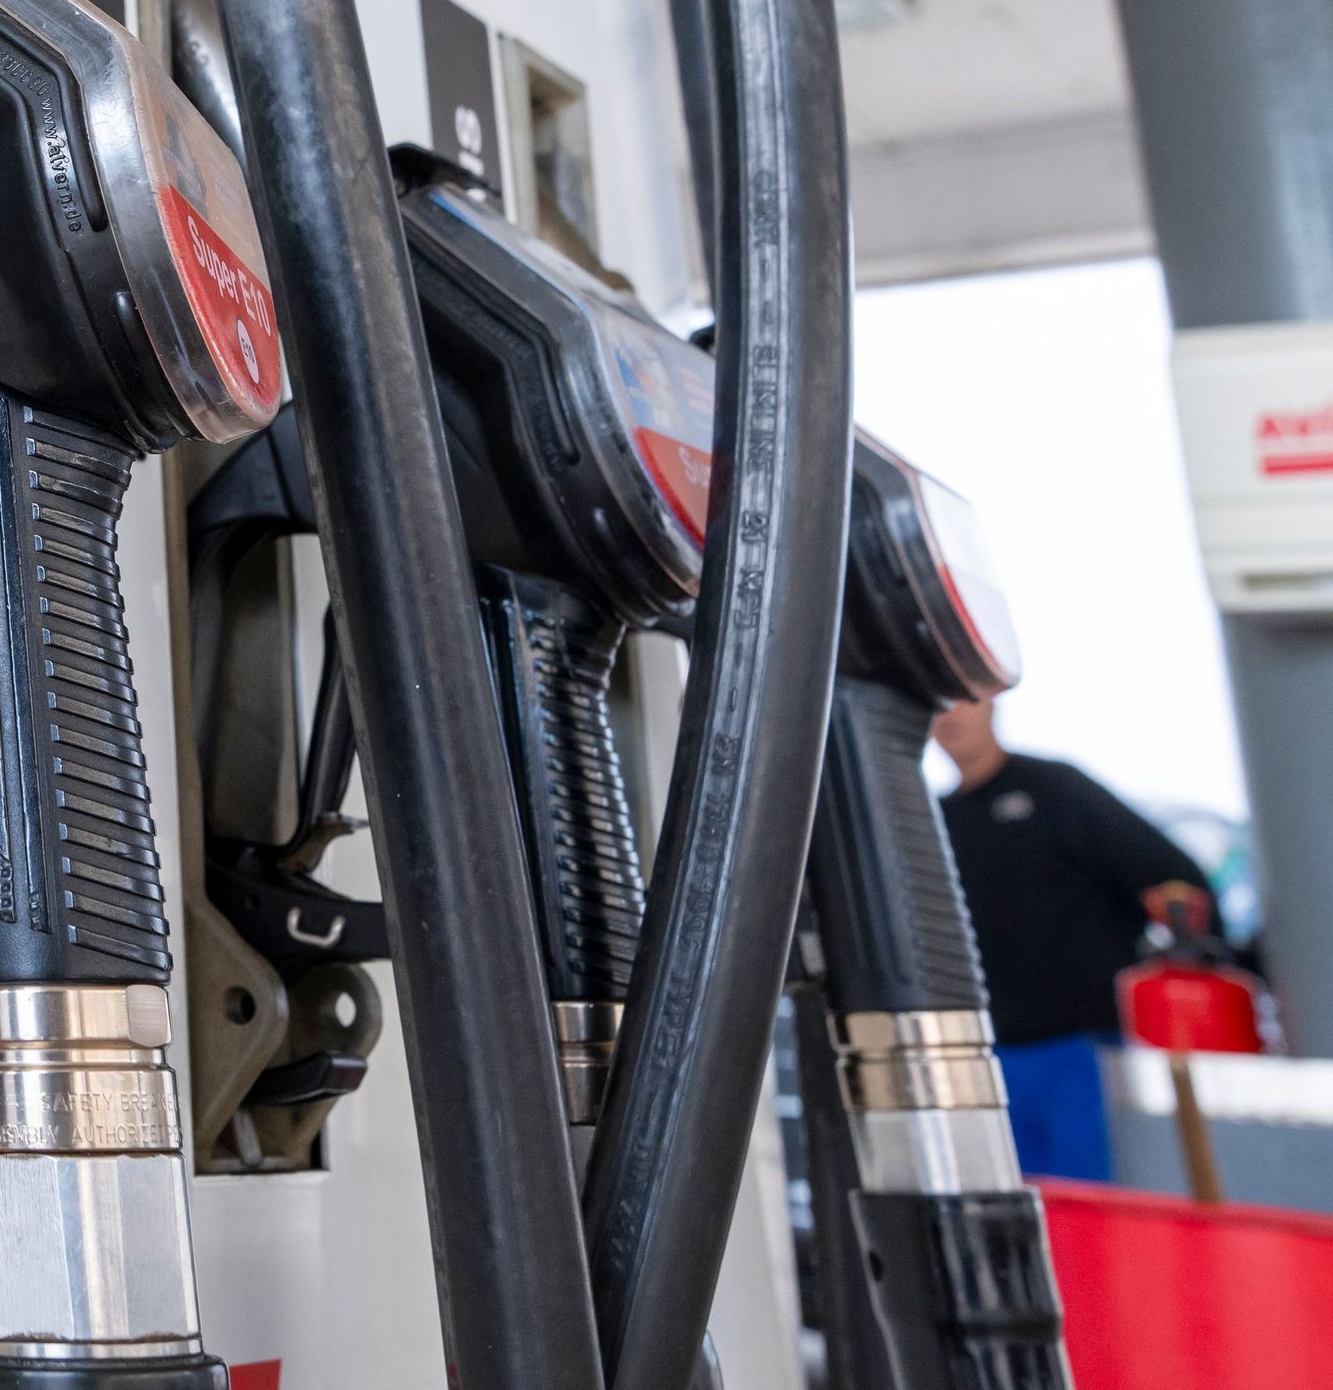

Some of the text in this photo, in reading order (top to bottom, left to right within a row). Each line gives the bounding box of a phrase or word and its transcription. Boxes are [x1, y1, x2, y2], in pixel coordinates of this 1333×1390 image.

[187, 214, 272, 338] Super E10
[41, 1091, 112, 1112] SAFETY
